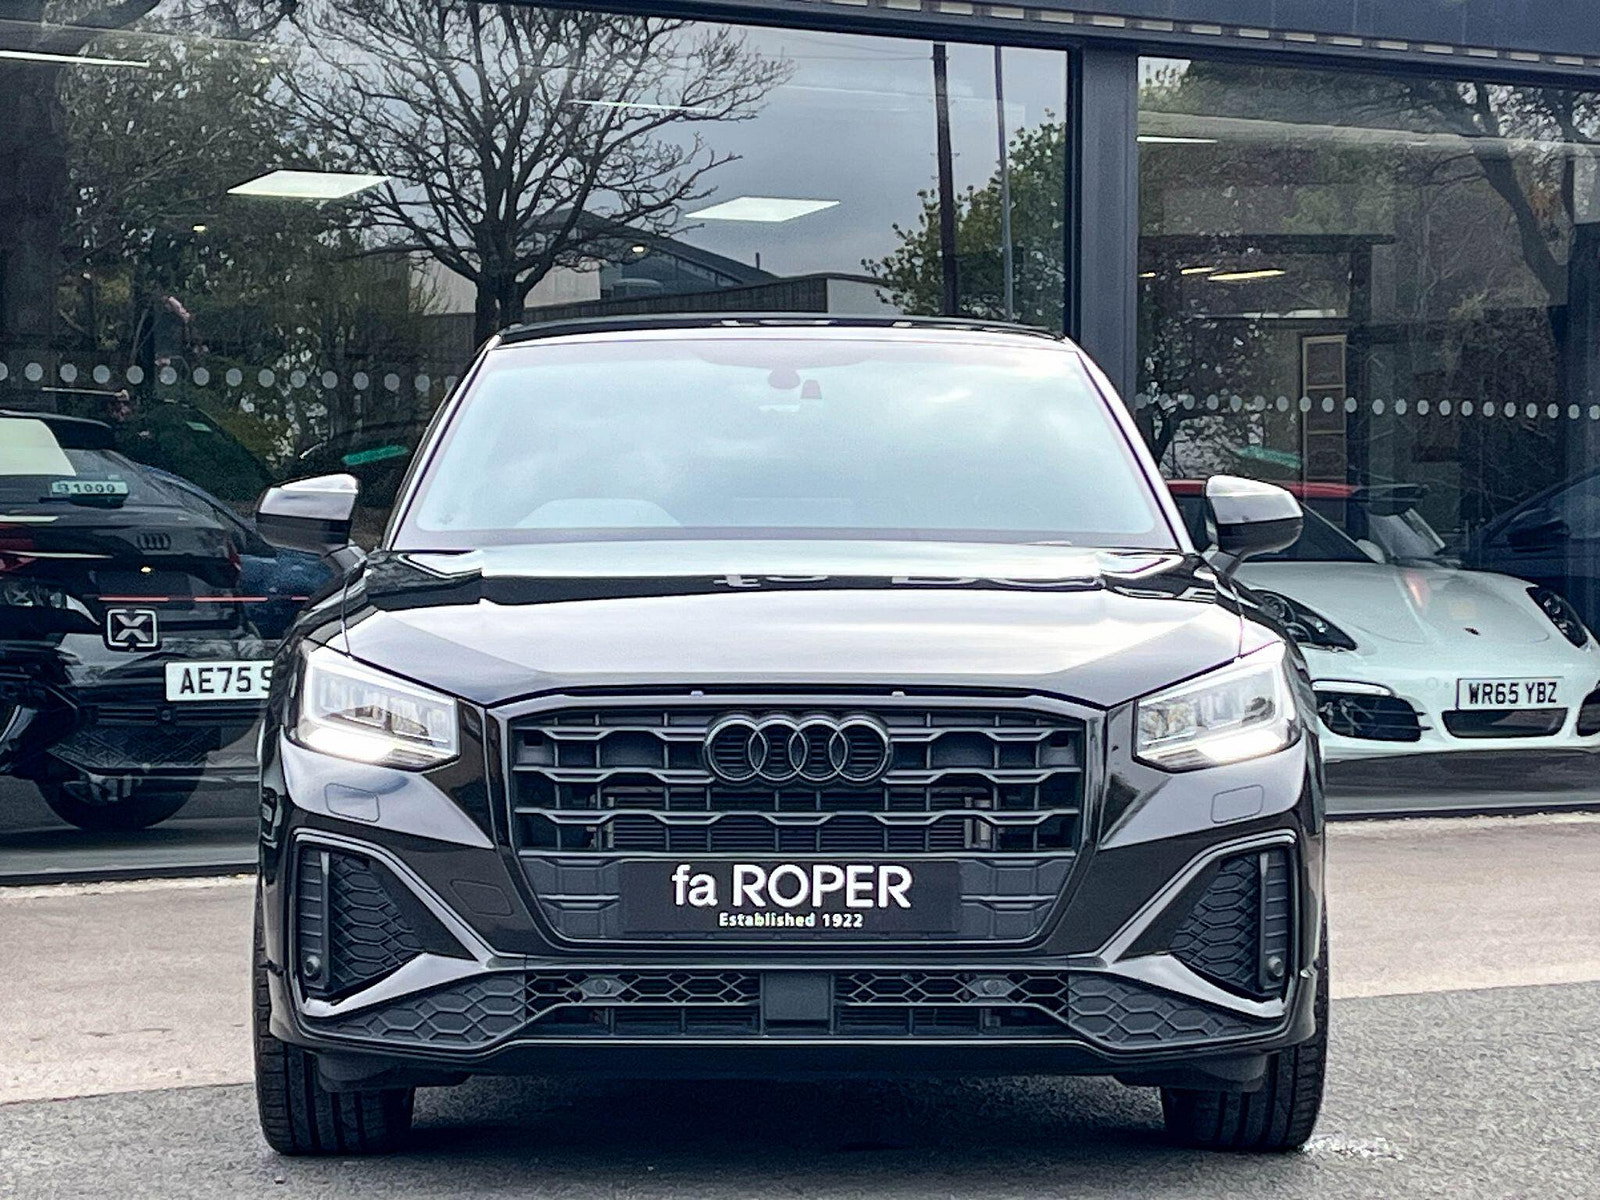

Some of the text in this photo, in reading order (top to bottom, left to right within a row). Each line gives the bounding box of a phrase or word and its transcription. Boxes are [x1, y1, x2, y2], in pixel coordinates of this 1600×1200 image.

[180, 667, 251, 693] AE75
[1469, 682, 1557, 704] WR65 YBZ
[671, 864, 913, 908] fa ROPER
[719, 912, 864, 927] Established 1922
